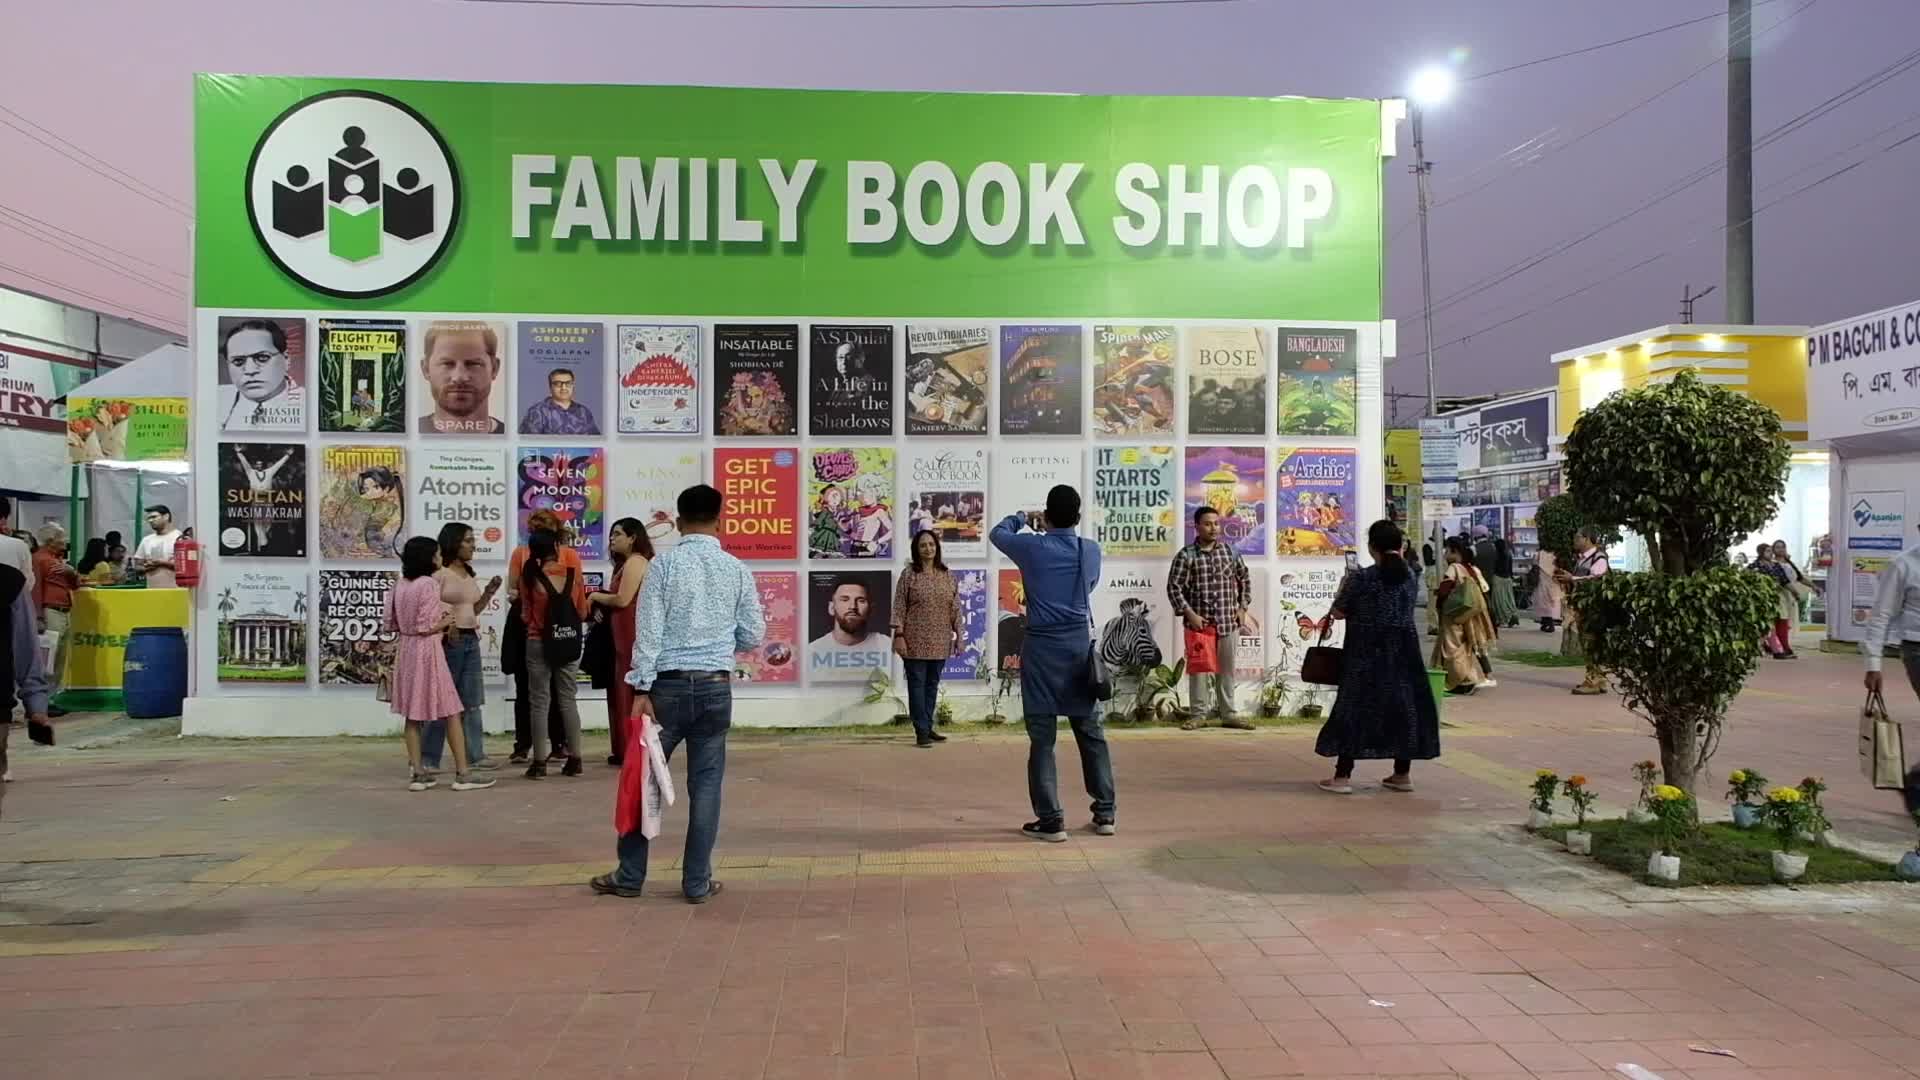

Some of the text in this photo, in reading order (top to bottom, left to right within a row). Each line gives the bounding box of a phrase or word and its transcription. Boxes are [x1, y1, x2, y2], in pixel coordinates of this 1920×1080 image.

[512, 154, 1333, 248] FAMILY BOOK SHOP
[331, 333, 395, 344] FLIGHT 714
[911, 328, 986, 342] REVOLUTIONARIES
[1808, 337, 1817, 367] P
[1820, 334, 1830, 364] M
[1833, 320, 1886, 361] BAGCHI
[1890, 316, 1901, 349] &
[345, 344, 374, 352] SYDNEY
[720, 340, 793, 350] INSATIABLE
[1288, 337, 1345, 352] BANGLADESH
[1200, 349, 1257, 366] BOSE
[834, 376, 867, 391] Life
[872, 378, 888, 391] in
[628, 388, 688, 396] INDEPENDENCE
[862, 395, 889, 410] the
[435, 420, 485, 431] SPARE
[813, 413, 890, 429] Shadows
[911, 423, 945, 431] SANJEEV
[913, 456, 982, 471] CALCUTTA
[1010, 457, 1071, 465] GETTING
[1098, 448, 1113, 466] IT
[538, 468, 586, 478] SEVEN
[725, 458, 771, 475] GET
[1294, 456, 1346, 478] Archie
[912, 471, 983, 481] COOK BOOK
[1024, 471, 1056, 480] LOST
[1096, 468, 1161, 486] STARTS
[419, 476, 505, 496] Atomic
[533, 486, 592, 495] MOONS
[726, 479, 776, 494] EPIC
[227, 489, 302, 503] SULTAN
[1096, 490, 1170, 508] WITH US
[228, 507, 302, 518] WASIM AKRAM
[424, 501, 500, 521] Habits
[553, 502, 572, 511] OF
[726, 498, 776, 514] SHIT
[1109, 513, 1153, 524] COLLEEN
[725, 518, 793, 534] DONE
[1098, 526, 1167, 542] HOOVER
[328, 578, 395, 590] GUINNESS
[1110, 578, 1152, 588] ANIMAL
[1291, 583, 1335, 591] CHILDREN'
[328, 606, 384, 617] RECORD
[812, 651, 887, 667] MESSI
